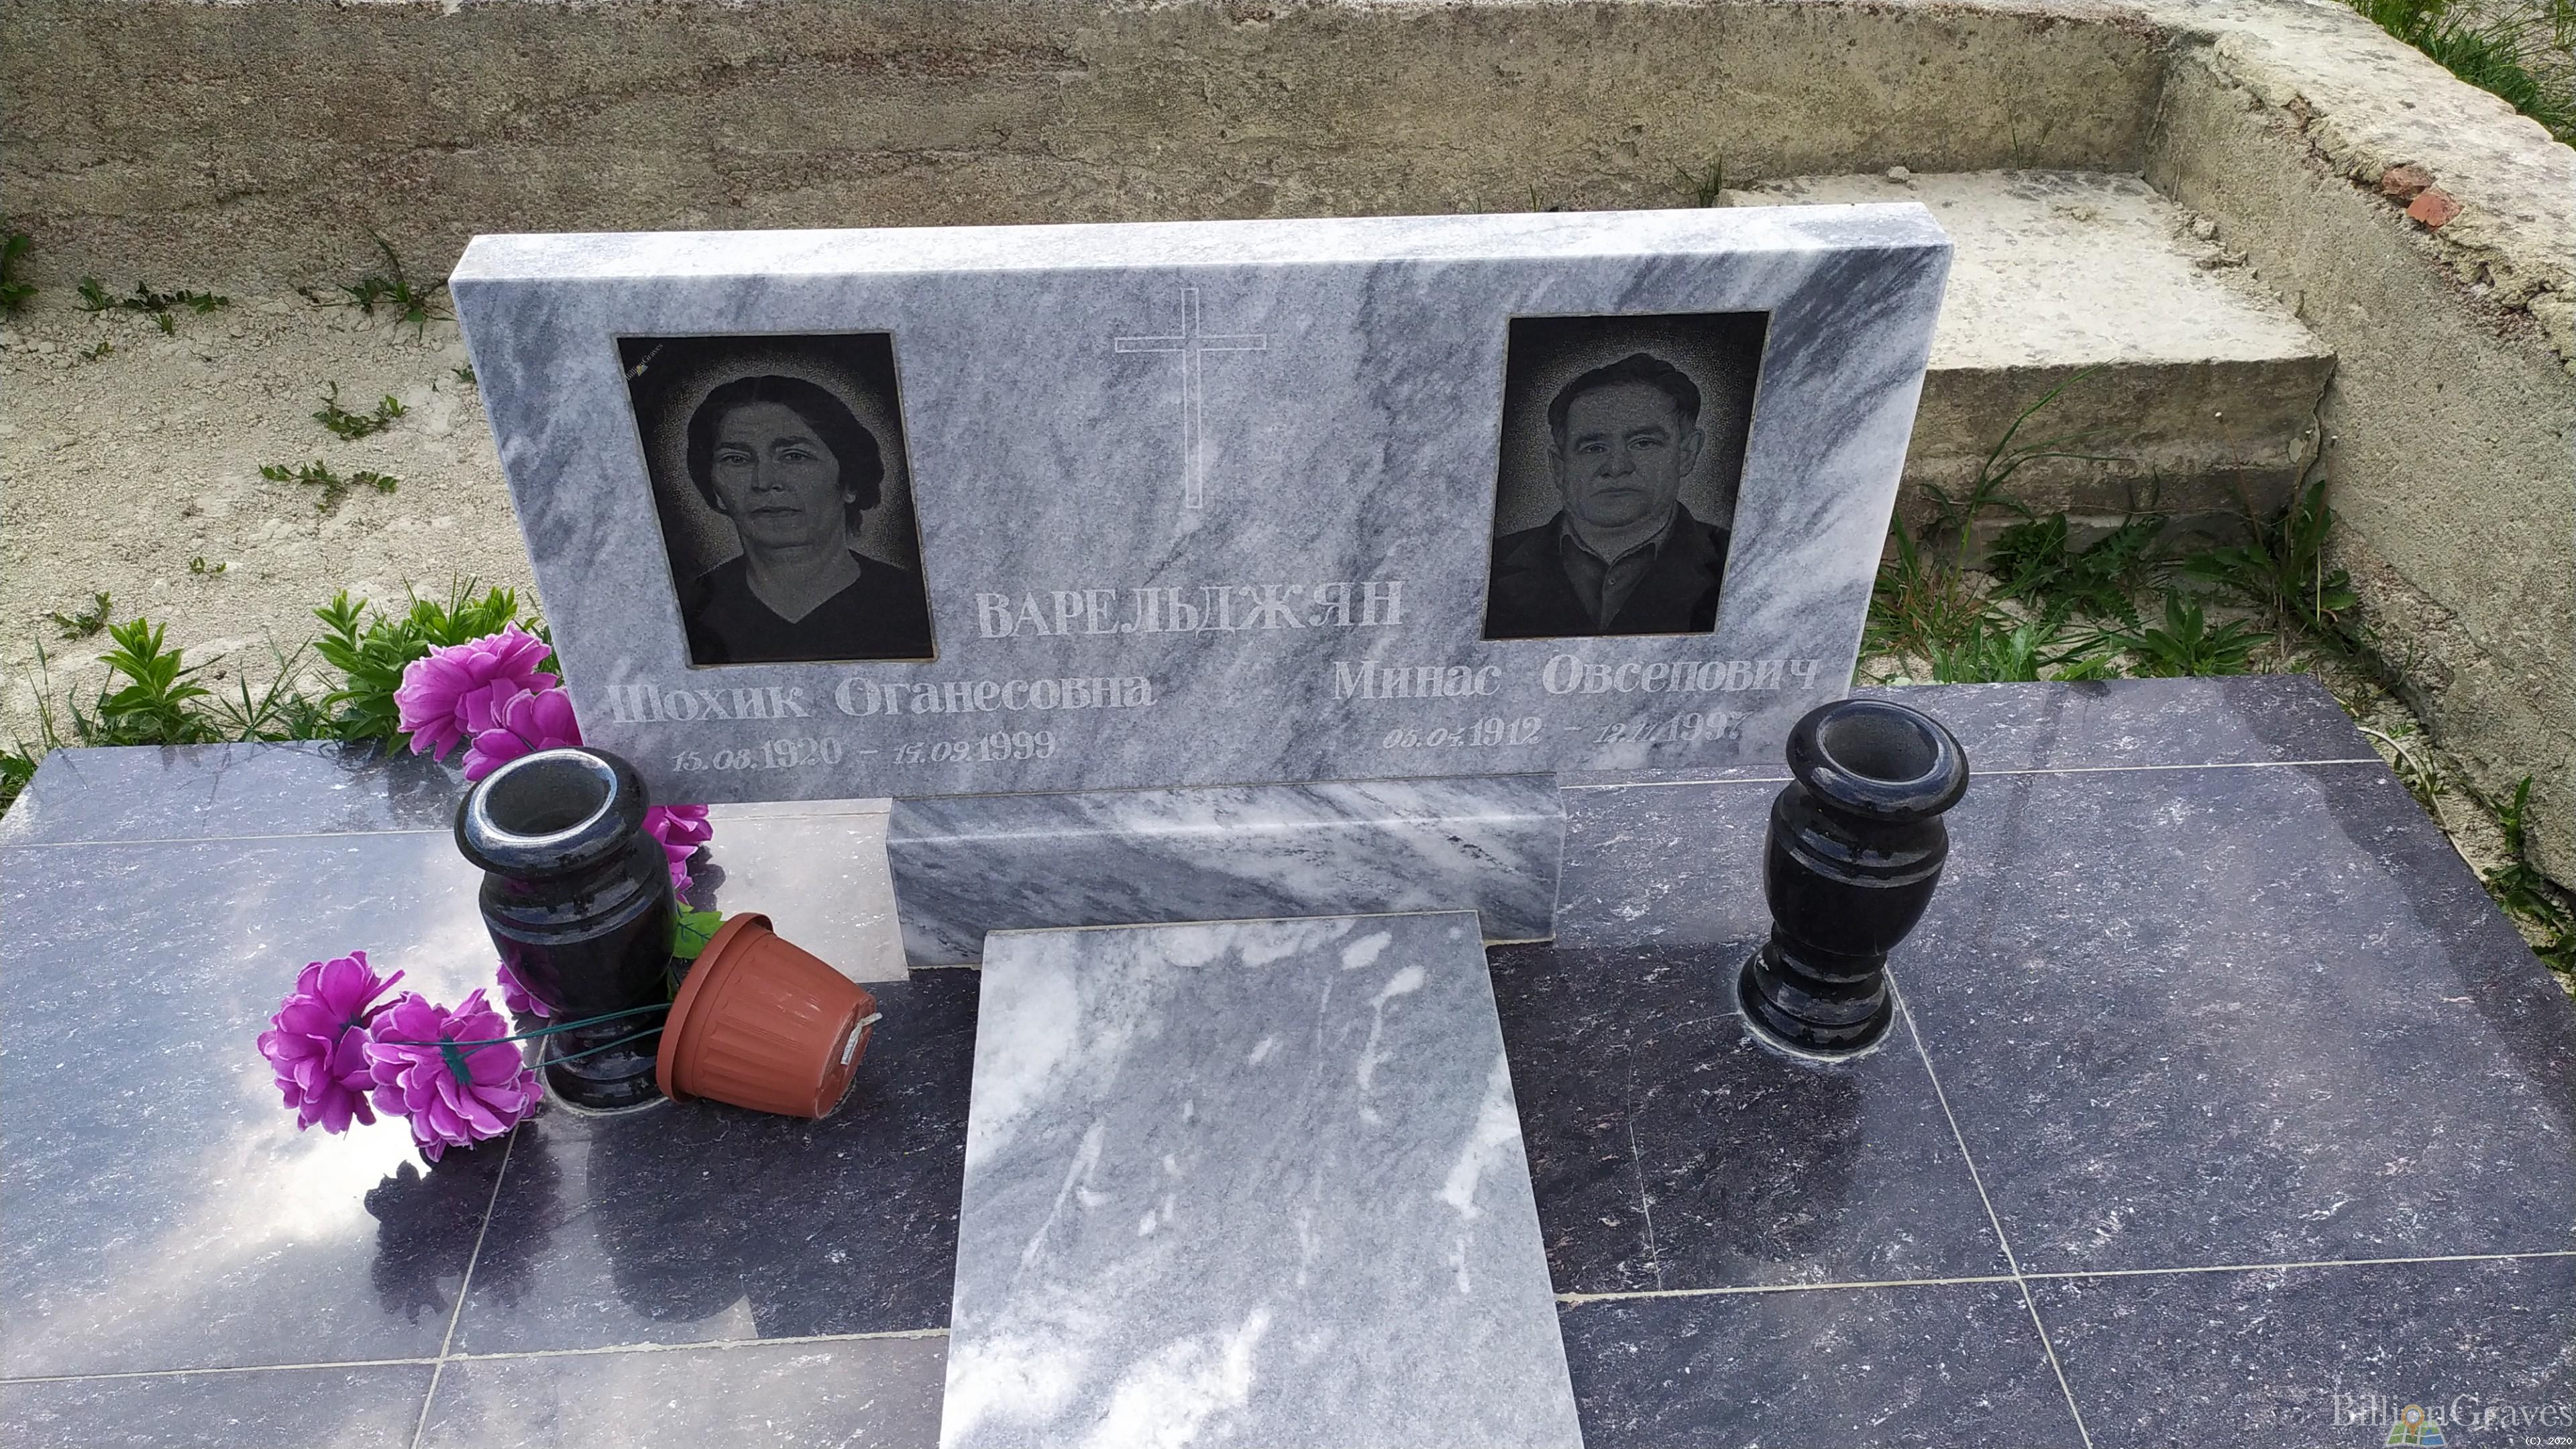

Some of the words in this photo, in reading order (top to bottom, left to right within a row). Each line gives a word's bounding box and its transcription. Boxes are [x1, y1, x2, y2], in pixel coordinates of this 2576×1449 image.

[975, 581, 1405, 638] ВАРЕЛЬДЖЯН
[604, 684, 812, 723] Шохик
[835, 676, 1159, 716] Оганесовна
[1332, 660, 1502, 700] Минас
[1542, 654, 1823, 694] Овсепович
